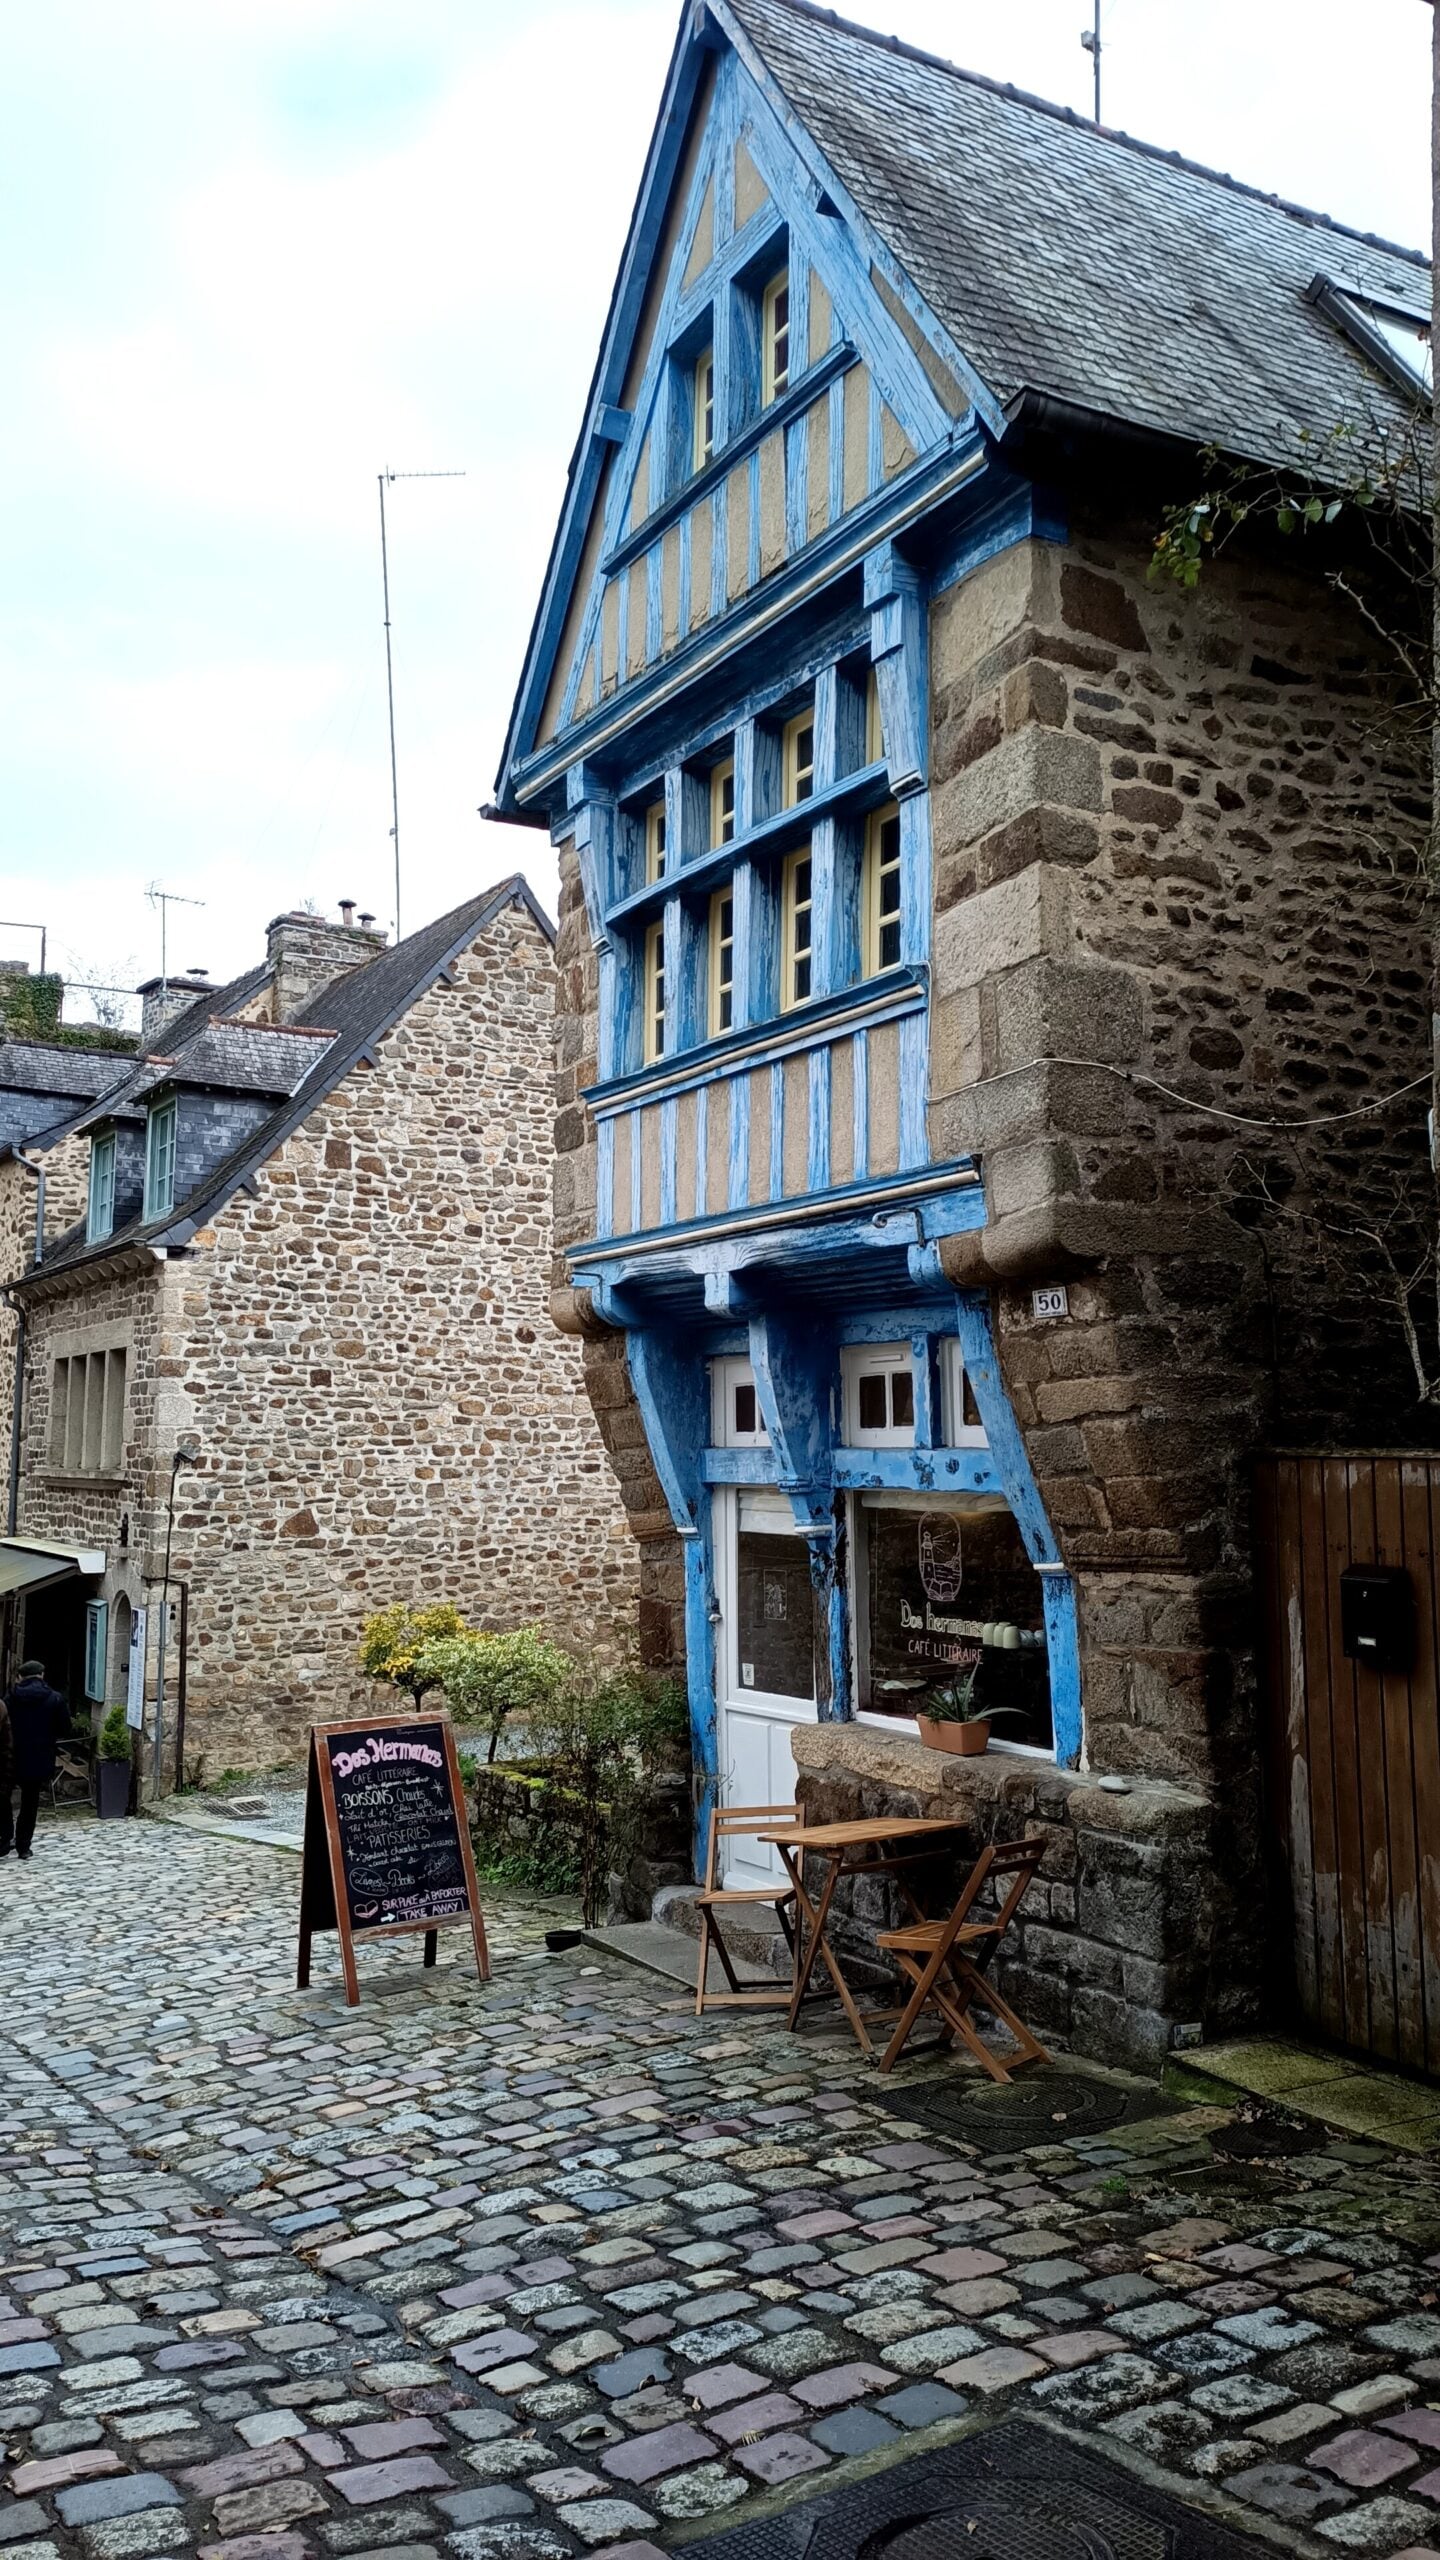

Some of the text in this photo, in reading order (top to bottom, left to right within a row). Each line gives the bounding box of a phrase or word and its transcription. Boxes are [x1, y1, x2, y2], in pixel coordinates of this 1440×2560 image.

[1038, 1293, 1061, 1311] 50
[900, 1599, 984, 1638] Dos hermanas
[908, 1638, 984, 1664] CAFÉ LITTÉRAIRE
[332, 1738, 443, 1777] Dos Hermanas
[352, 1769, 374, 1786] CAFÉ
[377, 1766, 418, 1782] LITTÉRAIRE
[381, 1898, 399, 1911] SUR
[398, 1893, 420, 1909] PLACE
[400, 1902, 459, 1920] TAKE AWAY
